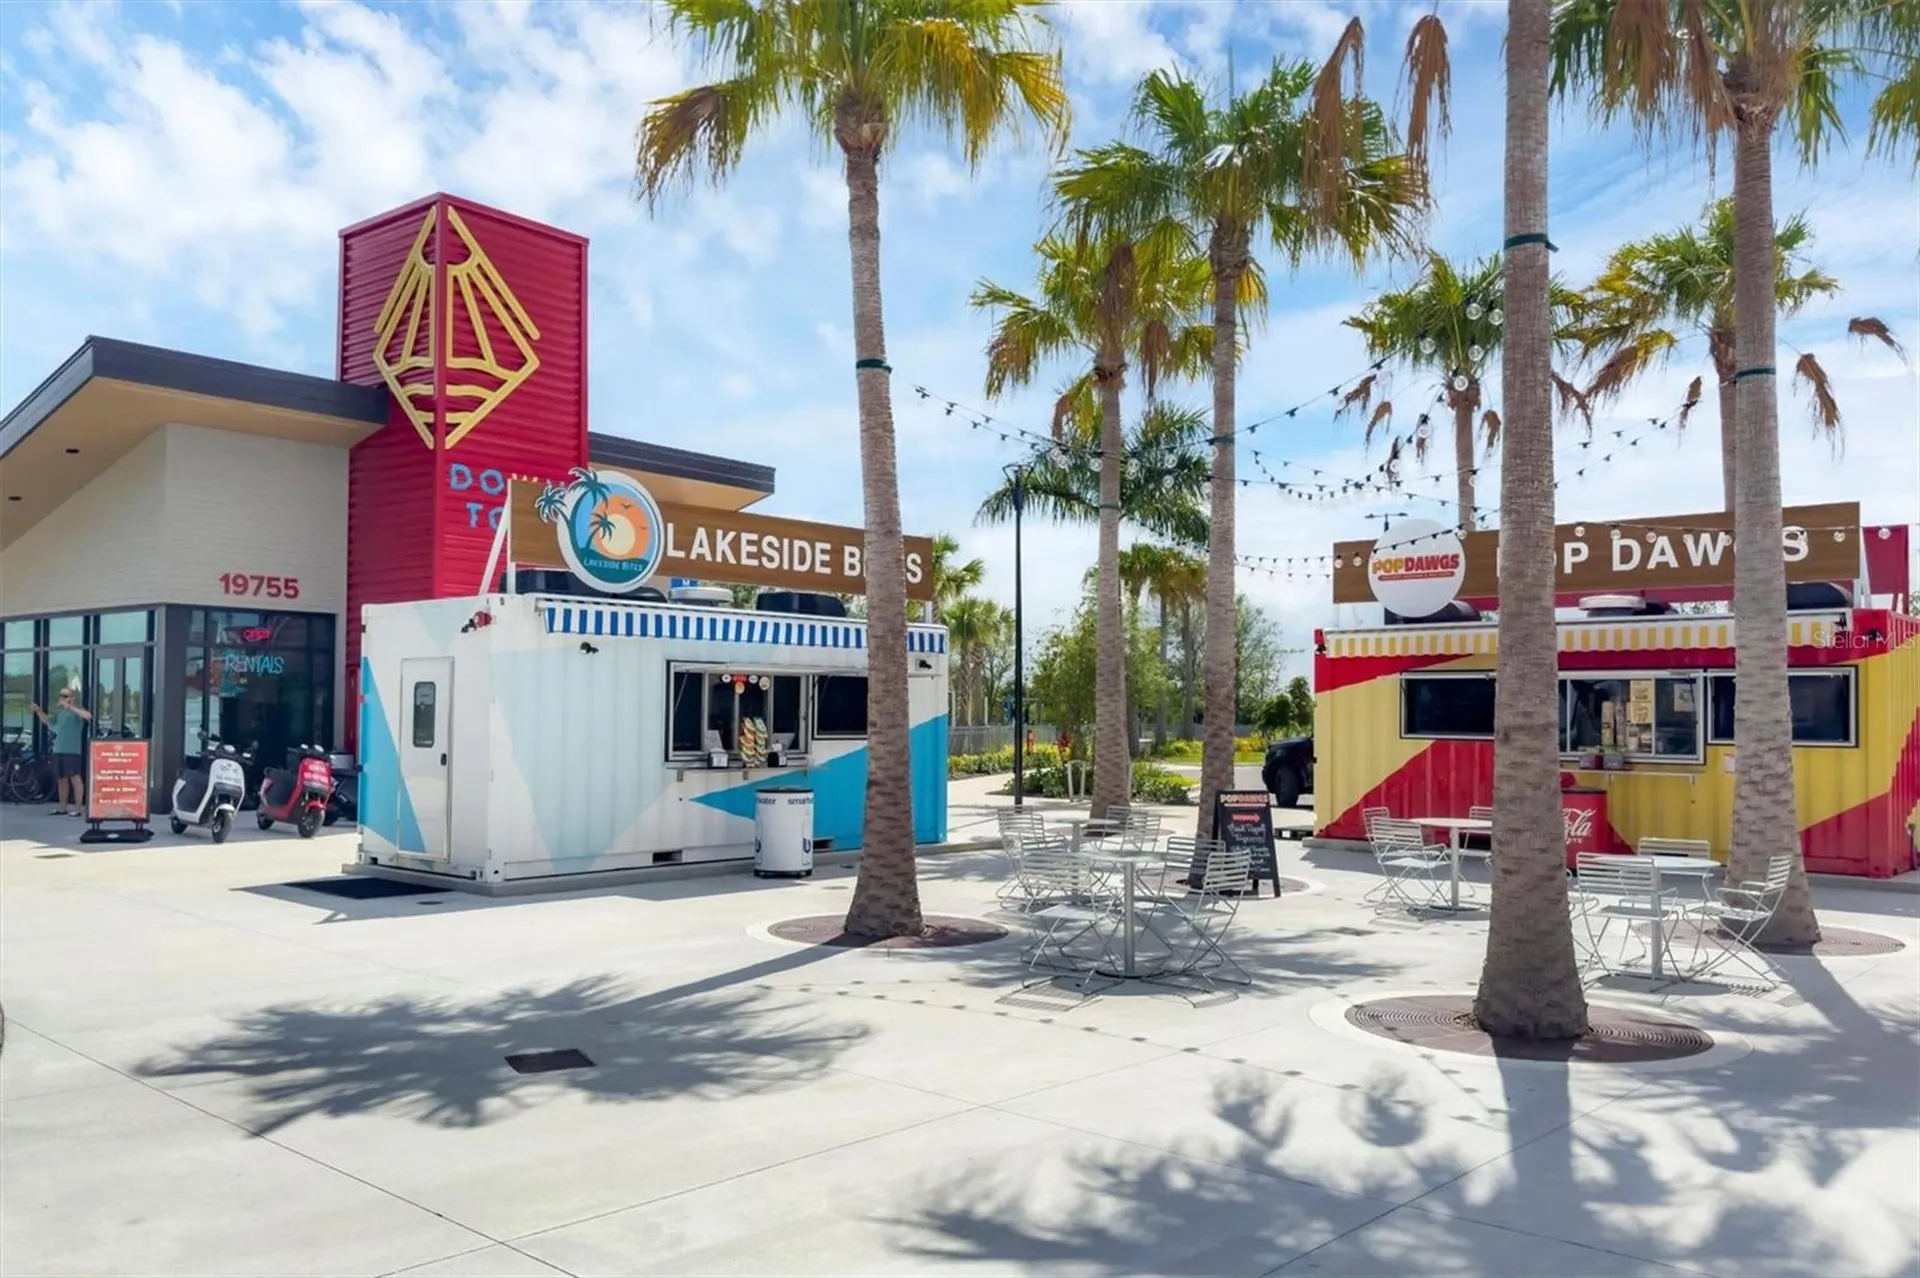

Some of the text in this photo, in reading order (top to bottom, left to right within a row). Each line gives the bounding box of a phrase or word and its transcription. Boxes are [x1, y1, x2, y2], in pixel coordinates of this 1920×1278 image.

[466, 502, 505, 530] TO
[666, 523, 832, 575] LAKESIDE
[1612, 525, 1809, 571] DAWS
[1373, 553, 1459, 574] POPDAWGS
[218, 573, 299, 599] 19755
[225, 654, 285, 675] RENTALS
